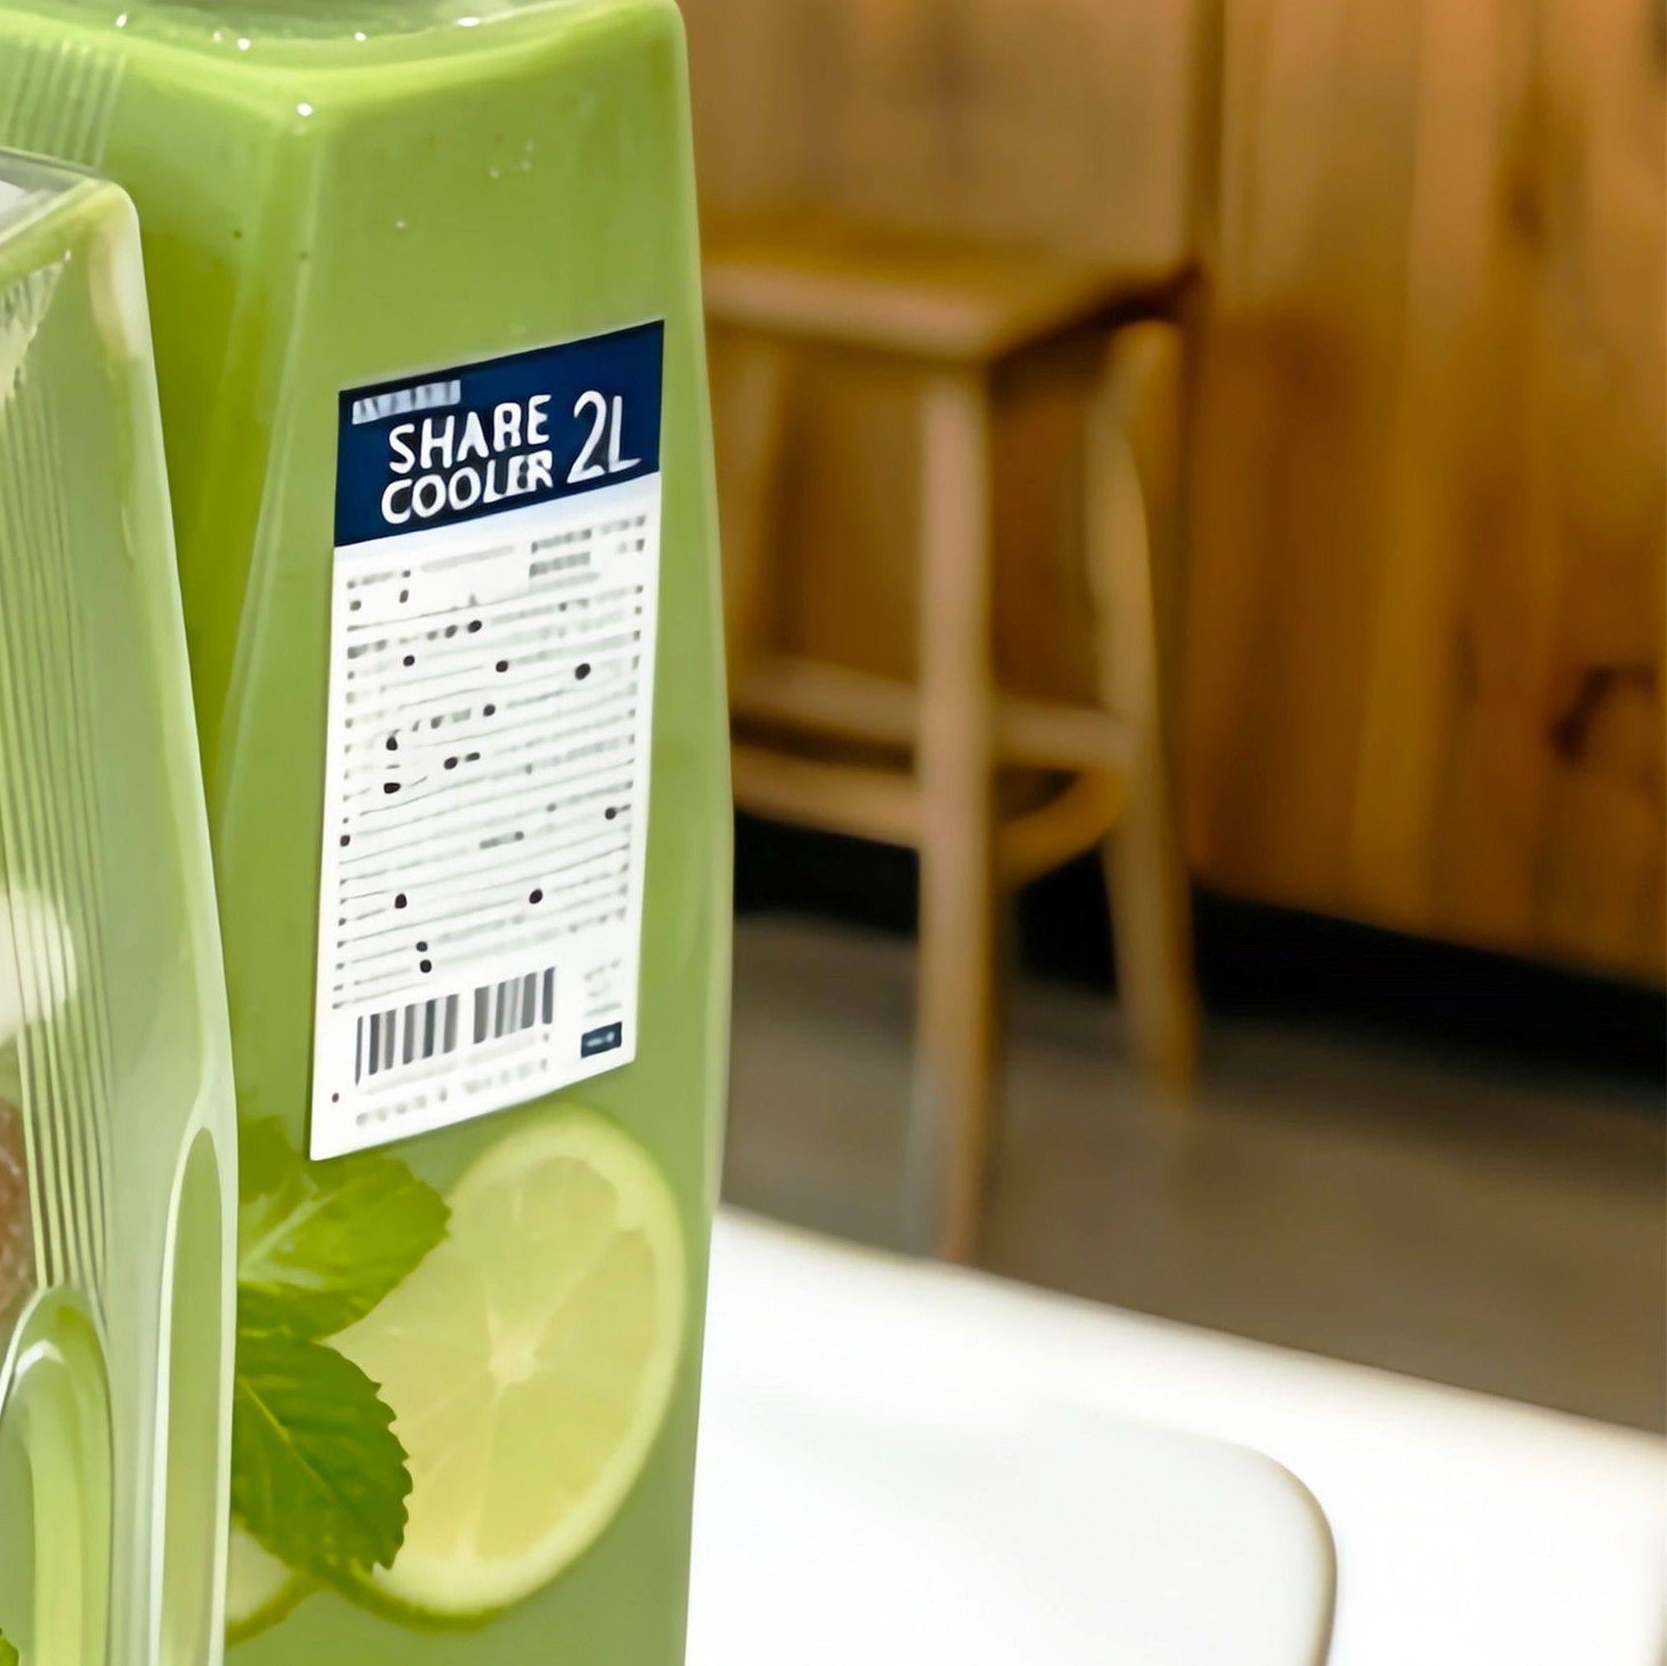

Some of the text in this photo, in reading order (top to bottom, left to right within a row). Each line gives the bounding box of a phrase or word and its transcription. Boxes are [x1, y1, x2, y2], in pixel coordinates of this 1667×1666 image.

[381, 390, 641, 524] COOLER 2L
[389, 394, 552, 474] SHARE
